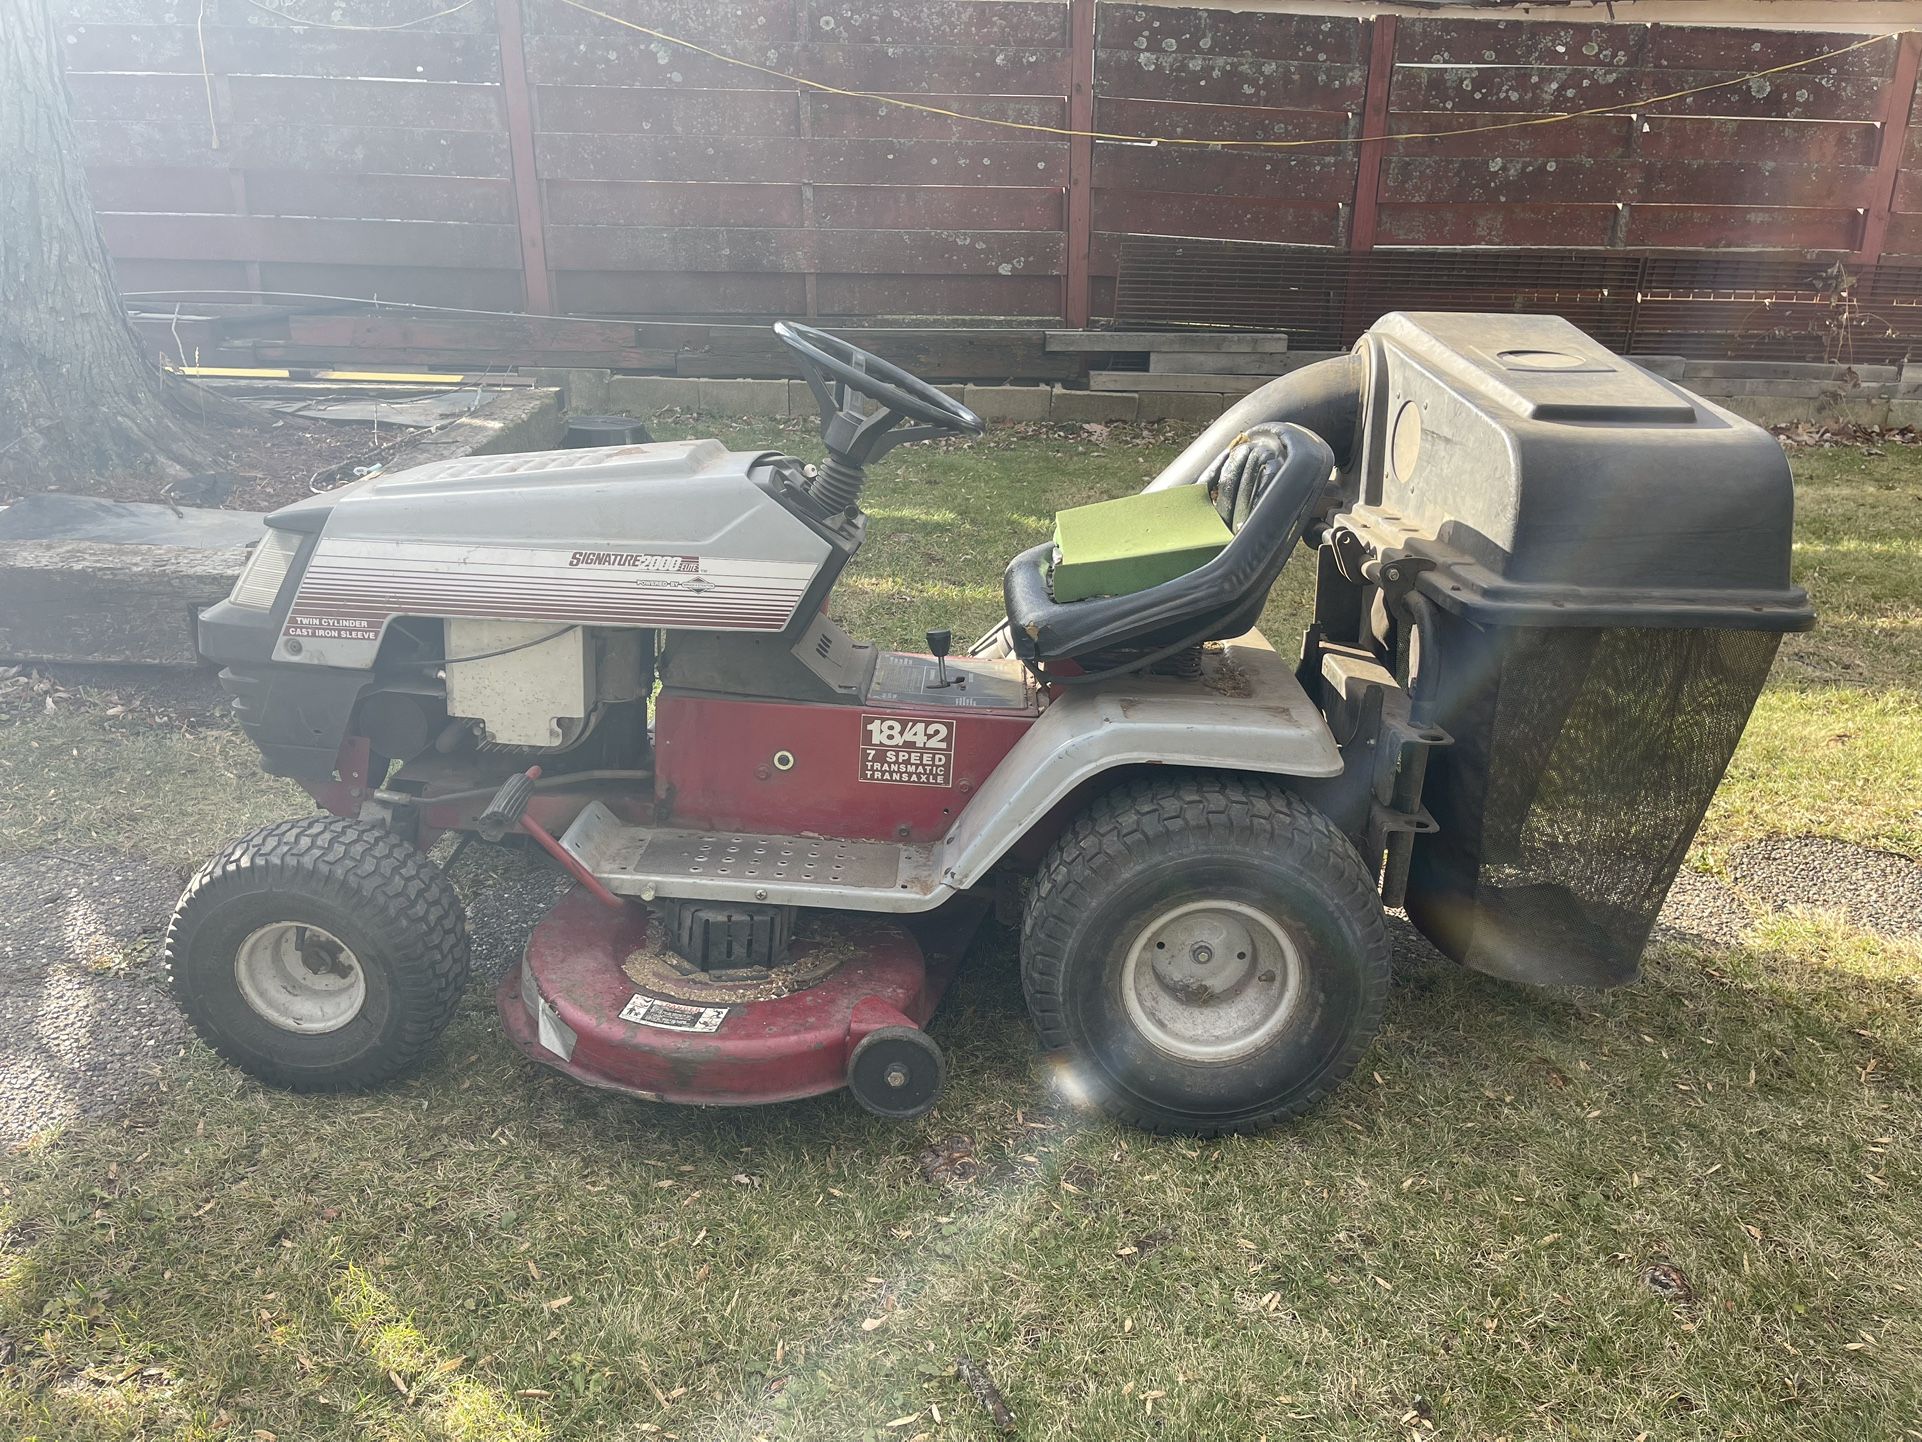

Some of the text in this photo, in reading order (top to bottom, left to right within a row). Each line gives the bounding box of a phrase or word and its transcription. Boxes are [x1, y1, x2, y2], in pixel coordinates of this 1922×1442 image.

[669, 580, 680, 588] BY
[296, 617, 368, 628] TWIN CYLINDER
[289, 628, 376, 640] CAST IRON SLEEVE
[866, 719, 948, 749] 18/42
[866, 750, 946, 766] 7 SPEED
[865, 762, 945, 775] TRANSMATIC
[865, 771, 944, 784] TRANSAXLE
